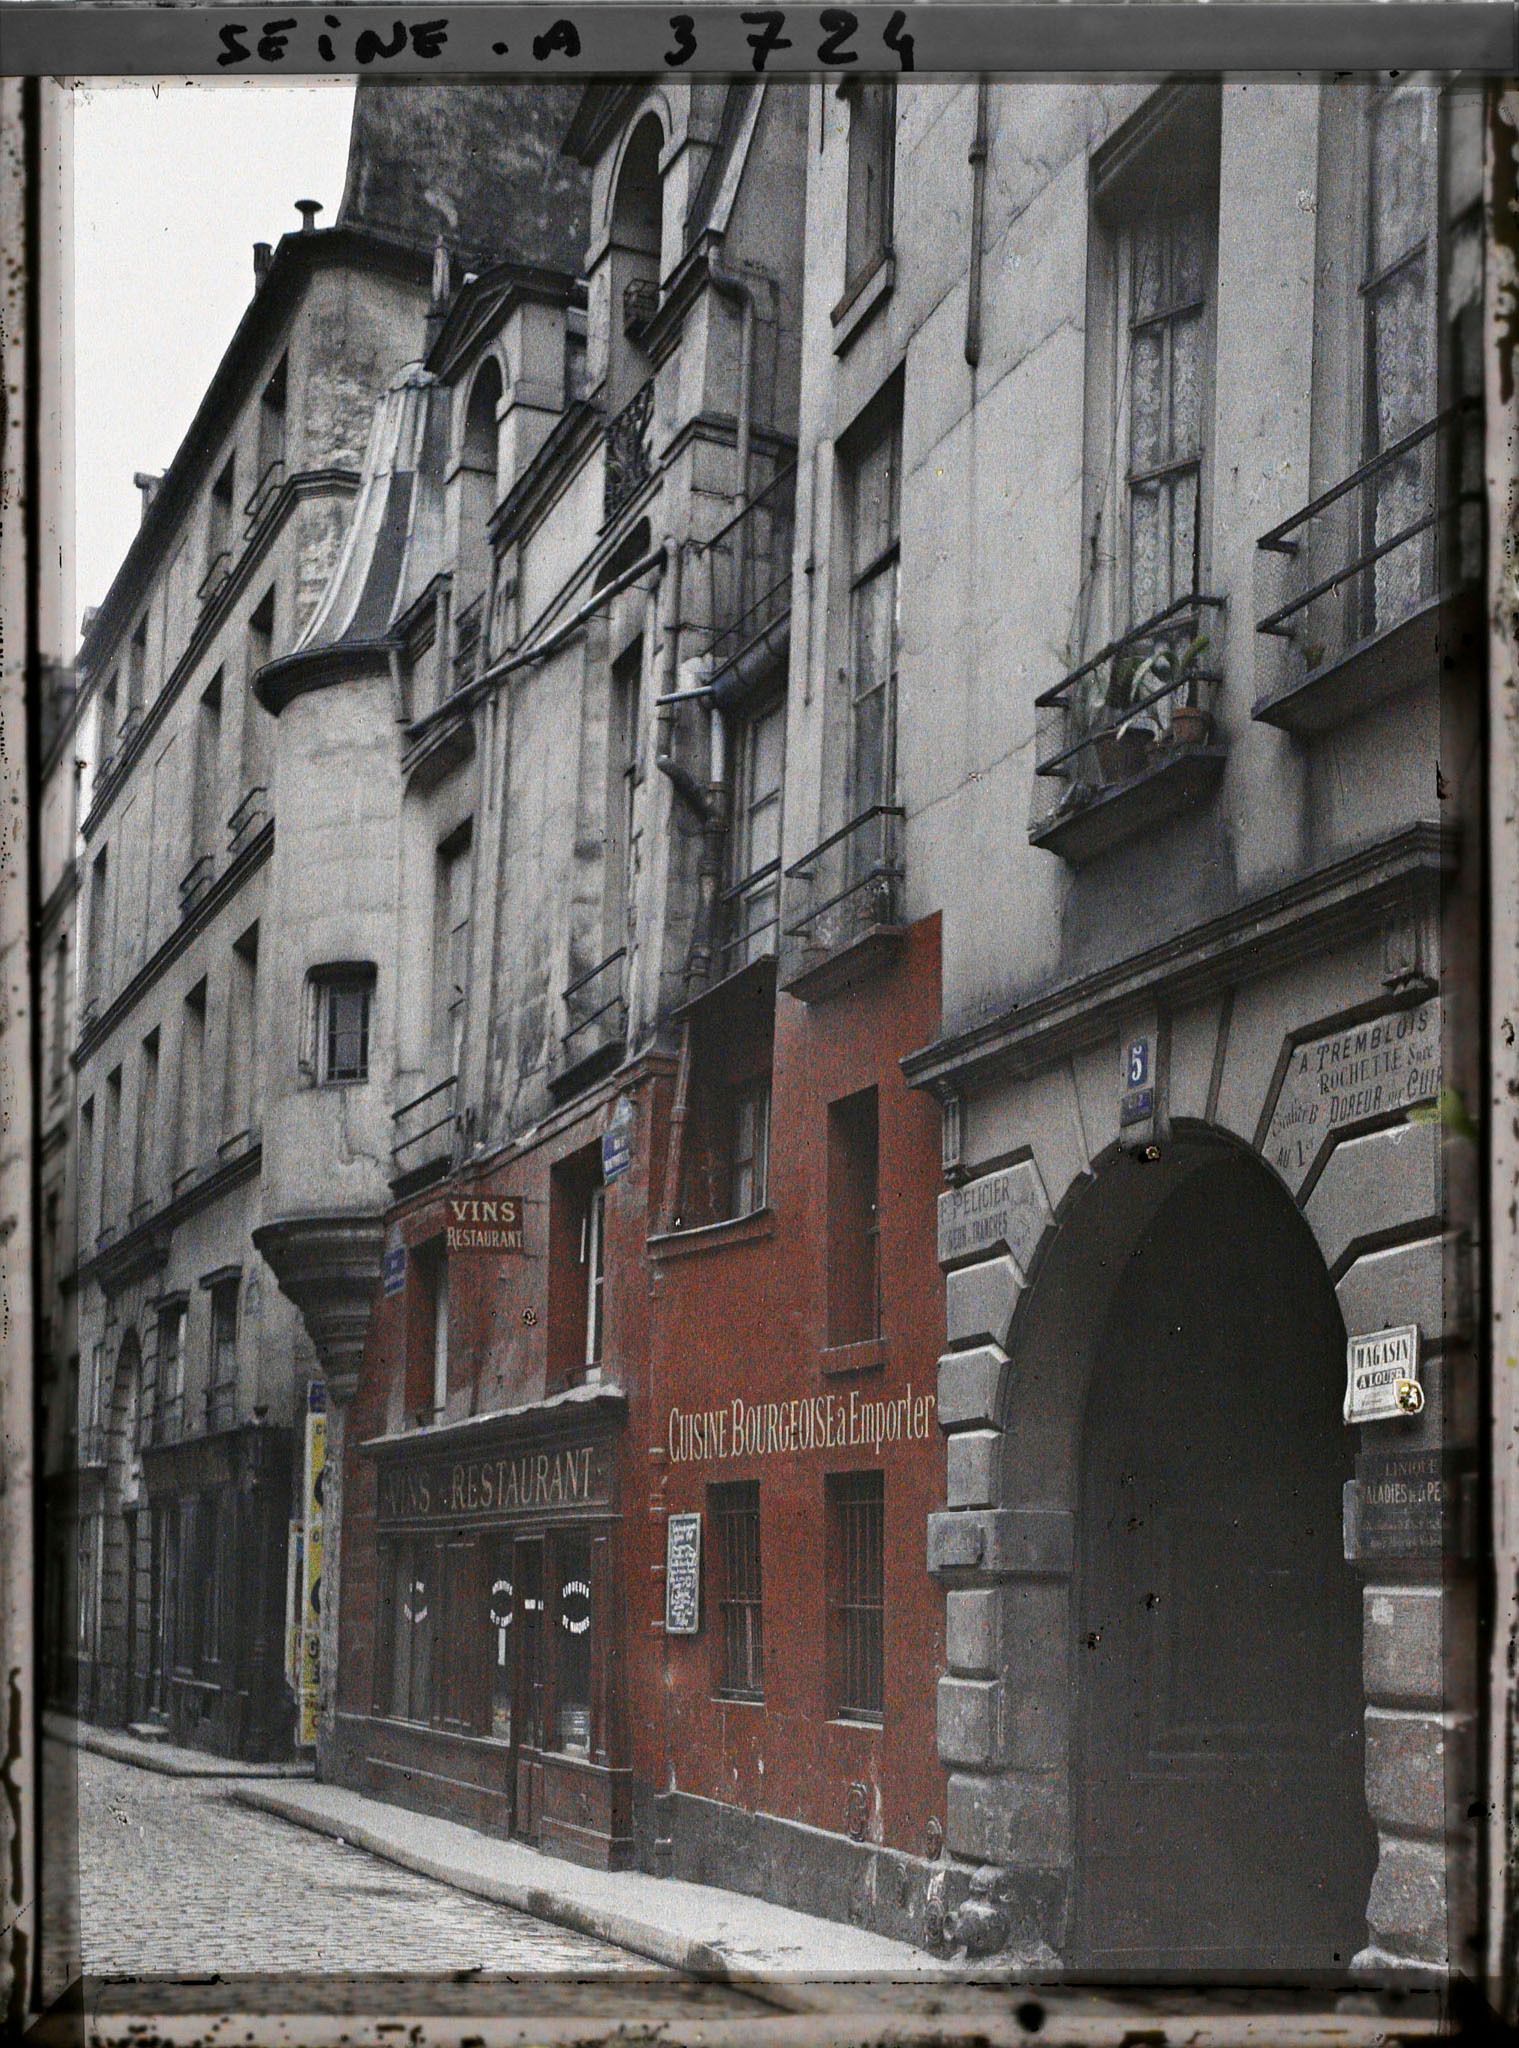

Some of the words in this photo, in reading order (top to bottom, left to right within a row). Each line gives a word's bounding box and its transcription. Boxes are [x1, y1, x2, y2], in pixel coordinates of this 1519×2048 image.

[1132, 1044, 1142, 1081] 5
[1320, 1049, 1403, 1096] ROCHETTE
[450, 1200, 516, 1223] VINS
[447, 1226, 523, 1252] RESTAURANT
[1356, 1338, 1409, 1369] MAGASIN
[1359, 1375, 1367, 1389] A
[668, 1407, 728, 1463] CUISINE
[730, 1395, 835, 1457] BOURGEOISE
[849, 1384, 936, 1455] Emporter
[450, 1446, 594, 1511] RESTAURANT
[1384, 1459, 1438, 1478] LINIQUE
[1365, 1483, 1408, 1505] ALADIES
